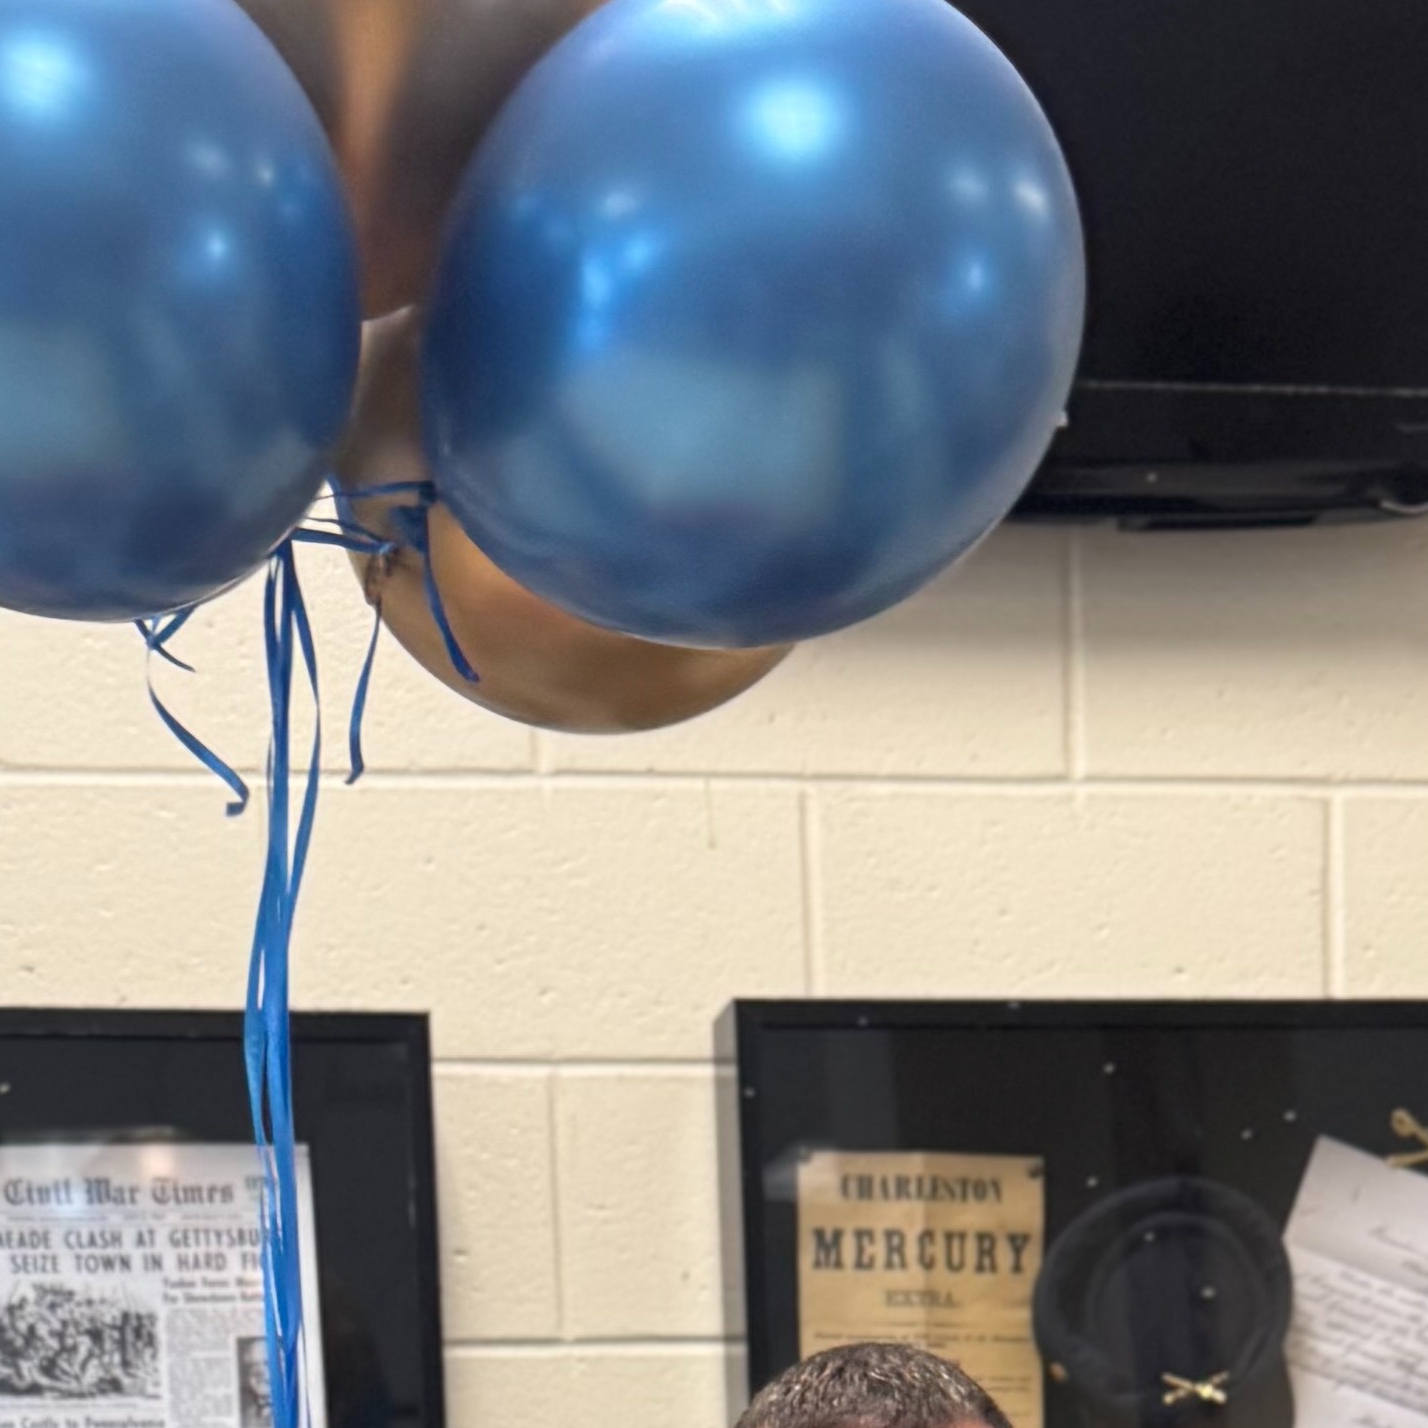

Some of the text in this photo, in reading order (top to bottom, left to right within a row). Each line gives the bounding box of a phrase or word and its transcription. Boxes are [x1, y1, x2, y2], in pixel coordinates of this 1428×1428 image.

[83, 1176, 140, 1206] War
[152, 1177, 234, 1206] Times
[840, 1174, 1003, 1203] CHARLESTON
[64, 1229, 123, 1250] CLASH
[135, 1229, 156, 1249] AT
[811, 1228, 1032, 1275] MERCURY
[10, 1254, 60, 1275] SEIZE
[74, 1254, 132, 1274] TOWN
[143, 1254, 164, 1273] IN
[176, 1252, 228, 1272] HARD
